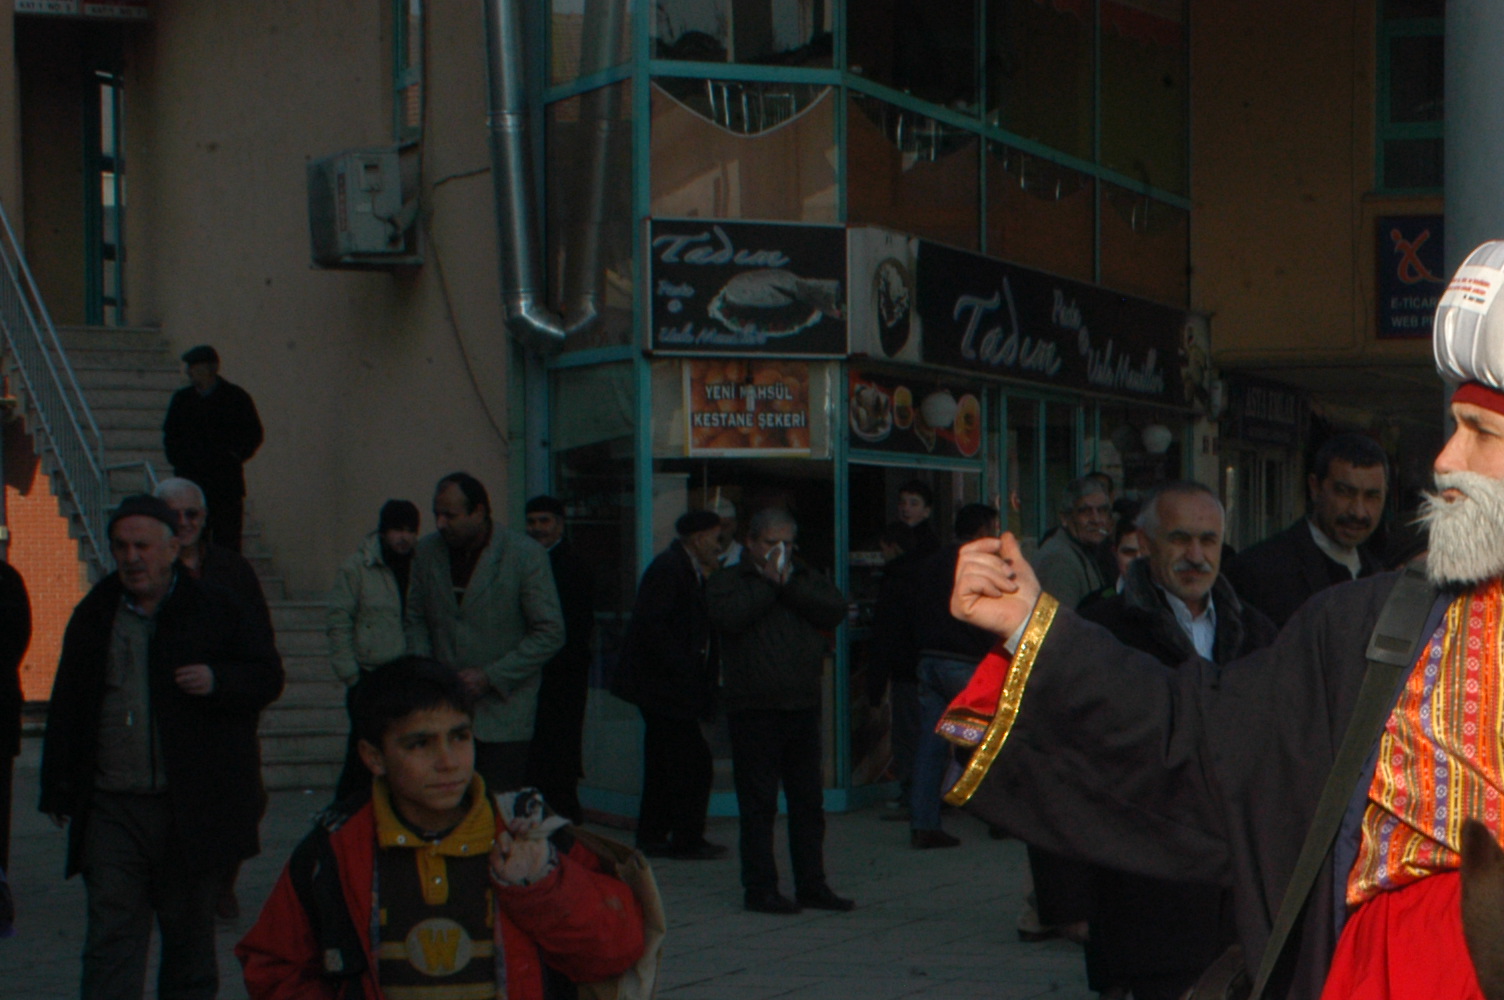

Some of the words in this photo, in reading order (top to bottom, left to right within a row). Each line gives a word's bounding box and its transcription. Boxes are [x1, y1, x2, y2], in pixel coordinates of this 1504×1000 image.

[705, 381, 736, 400] YENİ
[693, 412, 754, 428] KESTANE
[757, 410, 807, 430] ŞEKERİ
[416, 927, 461, 971] W
